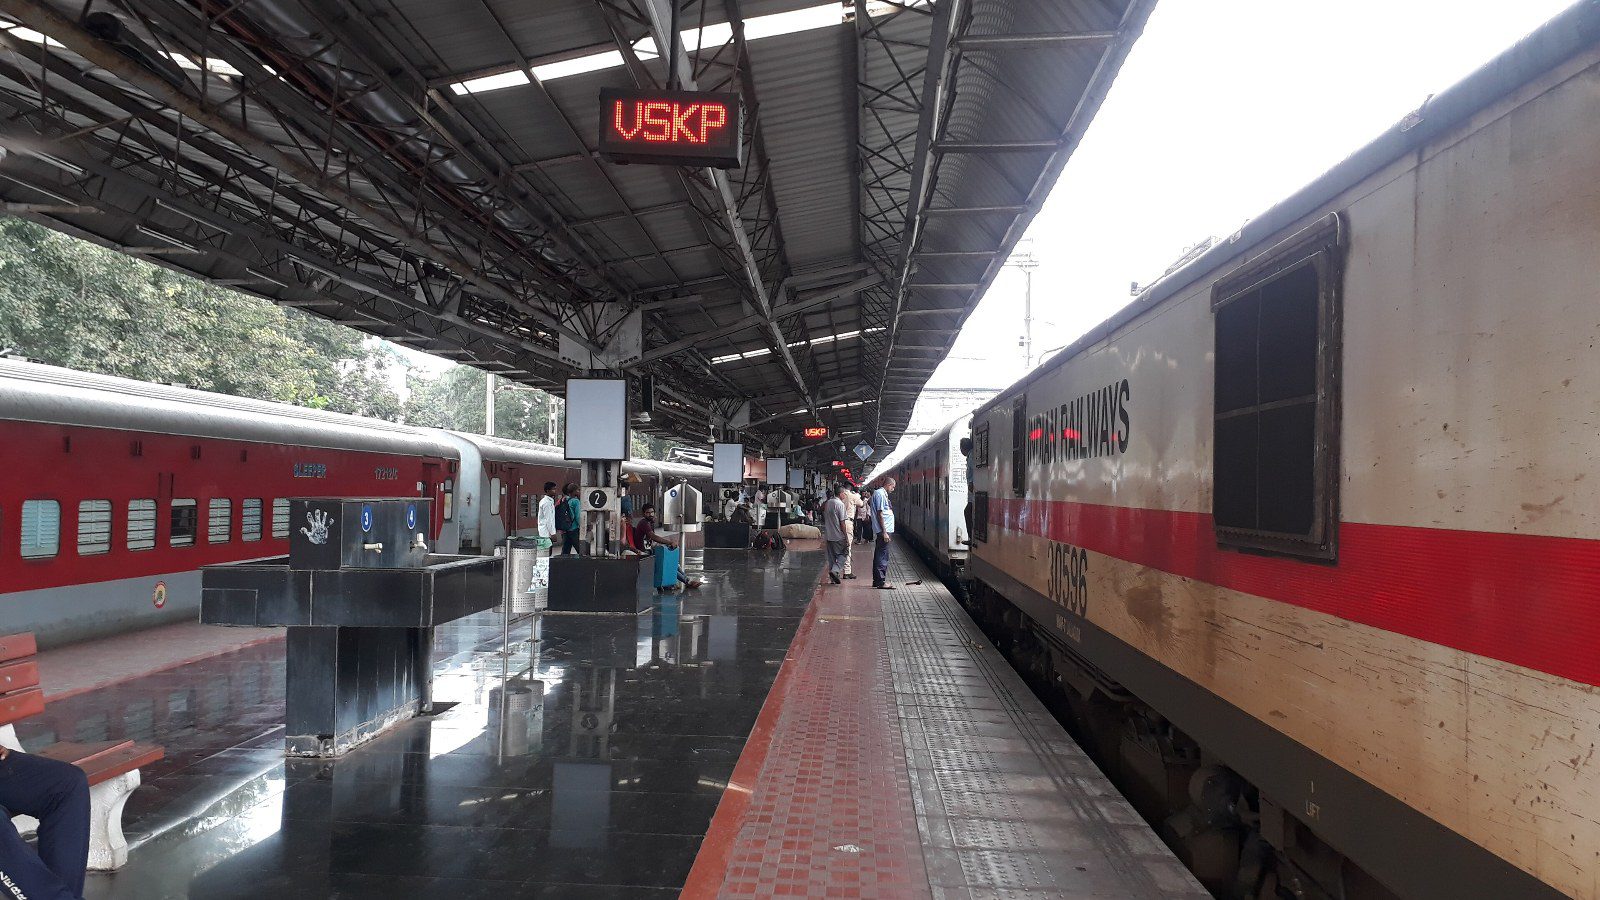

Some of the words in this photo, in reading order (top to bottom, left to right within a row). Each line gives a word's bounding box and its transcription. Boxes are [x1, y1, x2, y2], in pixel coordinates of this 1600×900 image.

[615, 100, 726, 143] VSKP
[1027, 407, 1058, 466] INDIAN
[1060, 379, 1130, 462] RAILWAYS
[804, 427, 827, 437] VSKP
[293, 463, 326, 479] SLEEPER
[594, 492, 600, 505] 2
[364, 511, 369, 526] 3
[409, 510, 414, 520] 4
[1047, 540, 1088, 618] 30596
